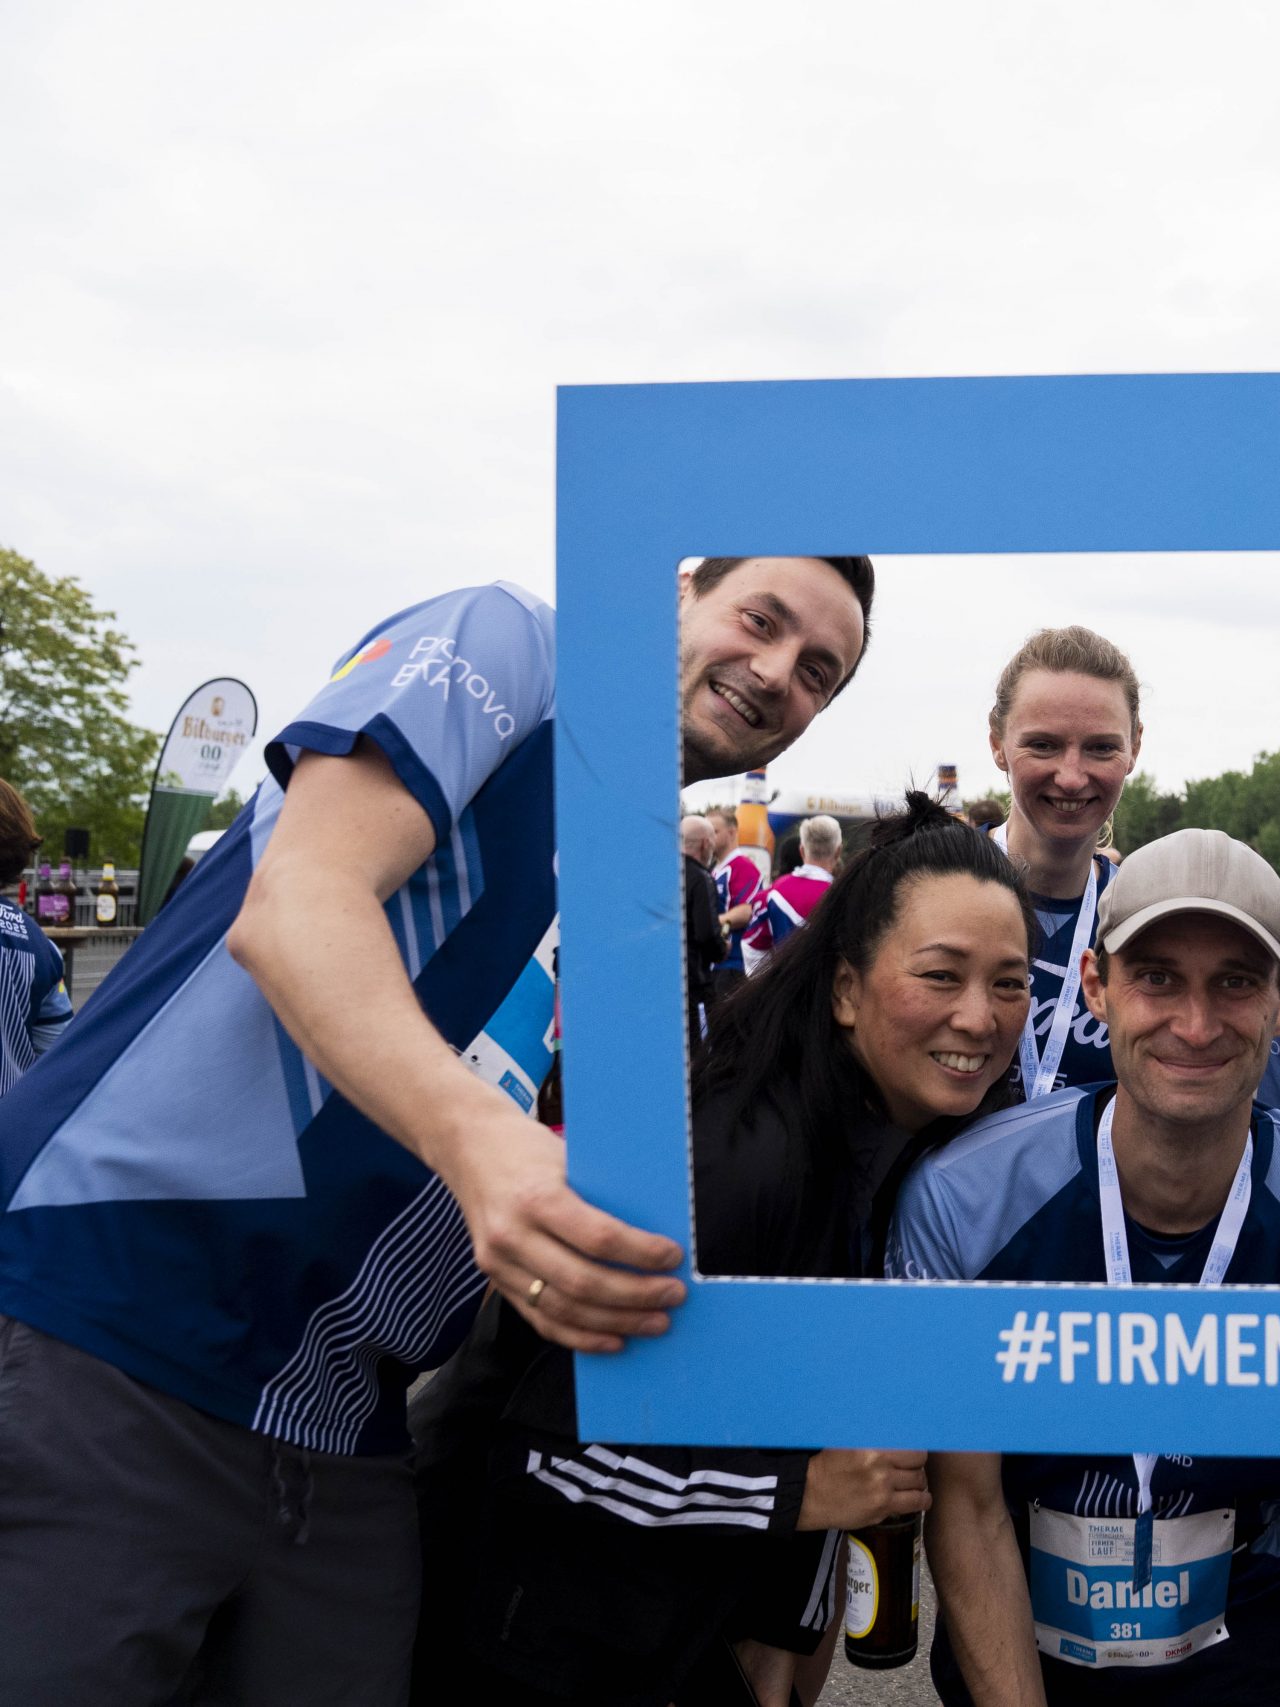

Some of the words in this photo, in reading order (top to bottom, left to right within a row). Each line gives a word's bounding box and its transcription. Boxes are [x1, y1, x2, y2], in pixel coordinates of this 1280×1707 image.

[1088, 1525, 1124, 1533] THERME
[1091, 1547, 1115, 1557] LAUF
[1110, 1622, 1142, 1639] 381
